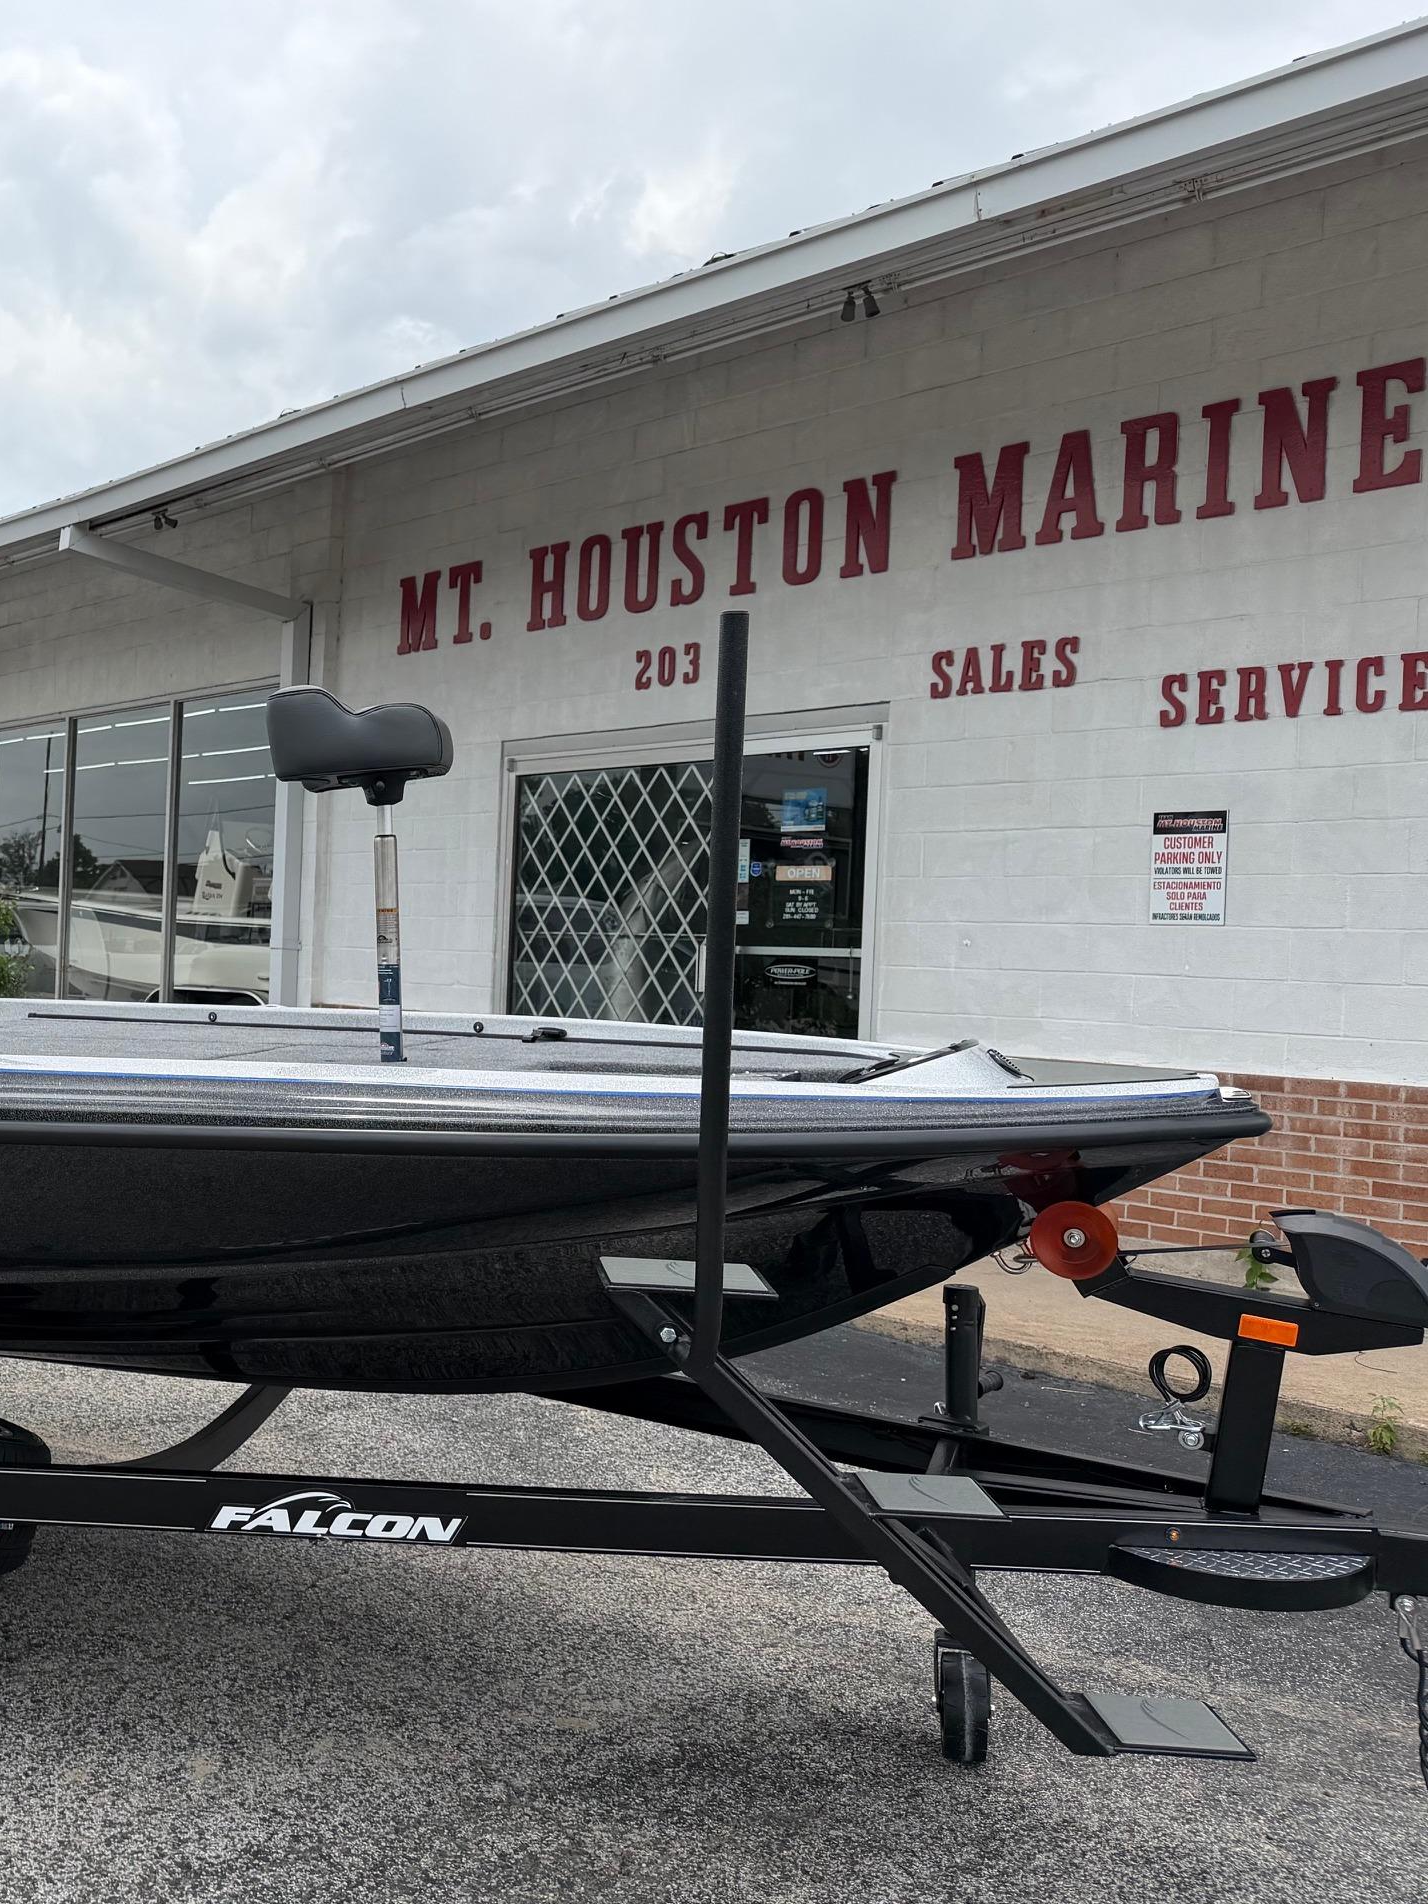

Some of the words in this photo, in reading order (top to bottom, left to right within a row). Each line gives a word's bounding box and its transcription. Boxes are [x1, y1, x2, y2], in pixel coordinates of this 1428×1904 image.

[396, 560, 491, 655] MT.
[527, 470, 897, 631] HOUSTON
[951, 357, 1427, 560] MARINE
[634, 642, 701, 691] 203
[930, 636, 1080, 699] SALES
[1159, 651, 1428, 728] SERVICE
[1164, 835, 1214, 850] CUSTOMER
[1154, 851, 1195, 865] PARKING
[1198, 851, 1223, 864] ONLY
[787, 868, 820, 879] OPEN
[1154, 866, 1182, 875] VIOLATORS
[1183, 867, 1195, 875] WILL
[1196, 867, 1203, 875] BE
[1204, 866, 1223, 875] TOWED
[1153, 881, 1222, 890] ESTACIONAMIENTO
[1166, 891, 1185, 900] SOLO
[1187, 891, 1207, 900] PARA
[1169, 902, 1204, 911] CLIENTES
[211, 1504, 462, 1541] FALCON
